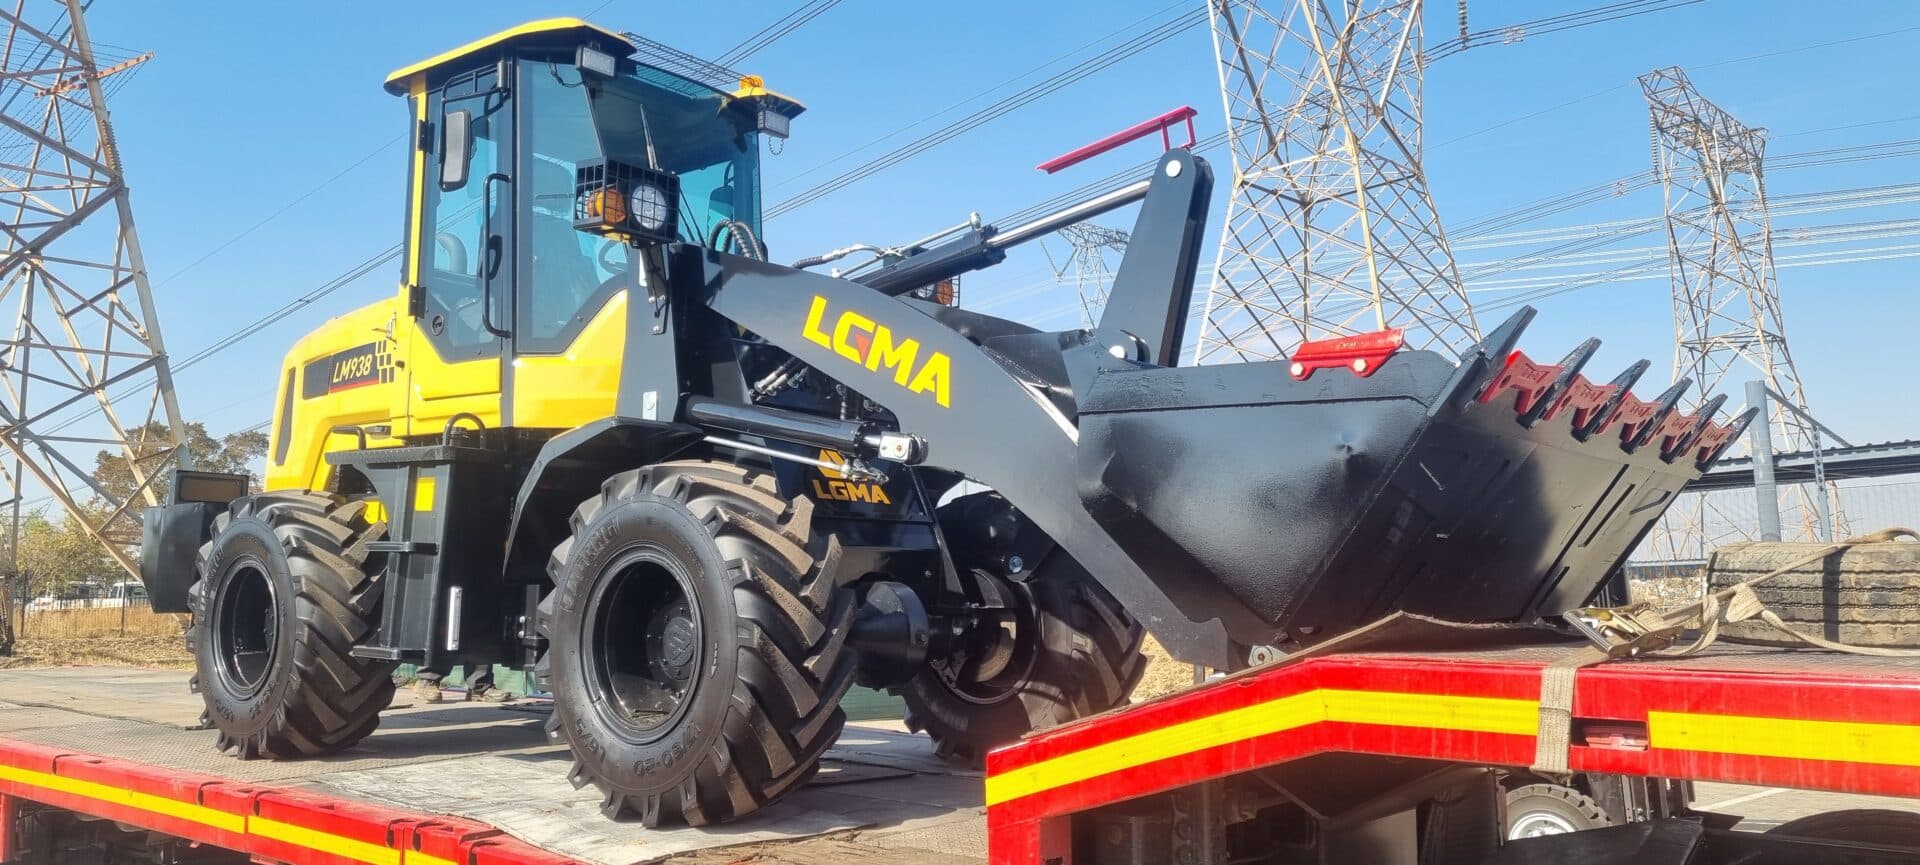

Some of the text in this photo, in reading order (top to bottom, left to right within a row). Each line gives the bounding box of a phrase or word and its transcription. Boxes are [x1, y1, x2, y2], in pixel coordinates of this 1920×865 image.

[802, 295, 951, 409] LGMA
[332, 354, 373, 384] LM938
[811, 479, 892, 505] LGMA
